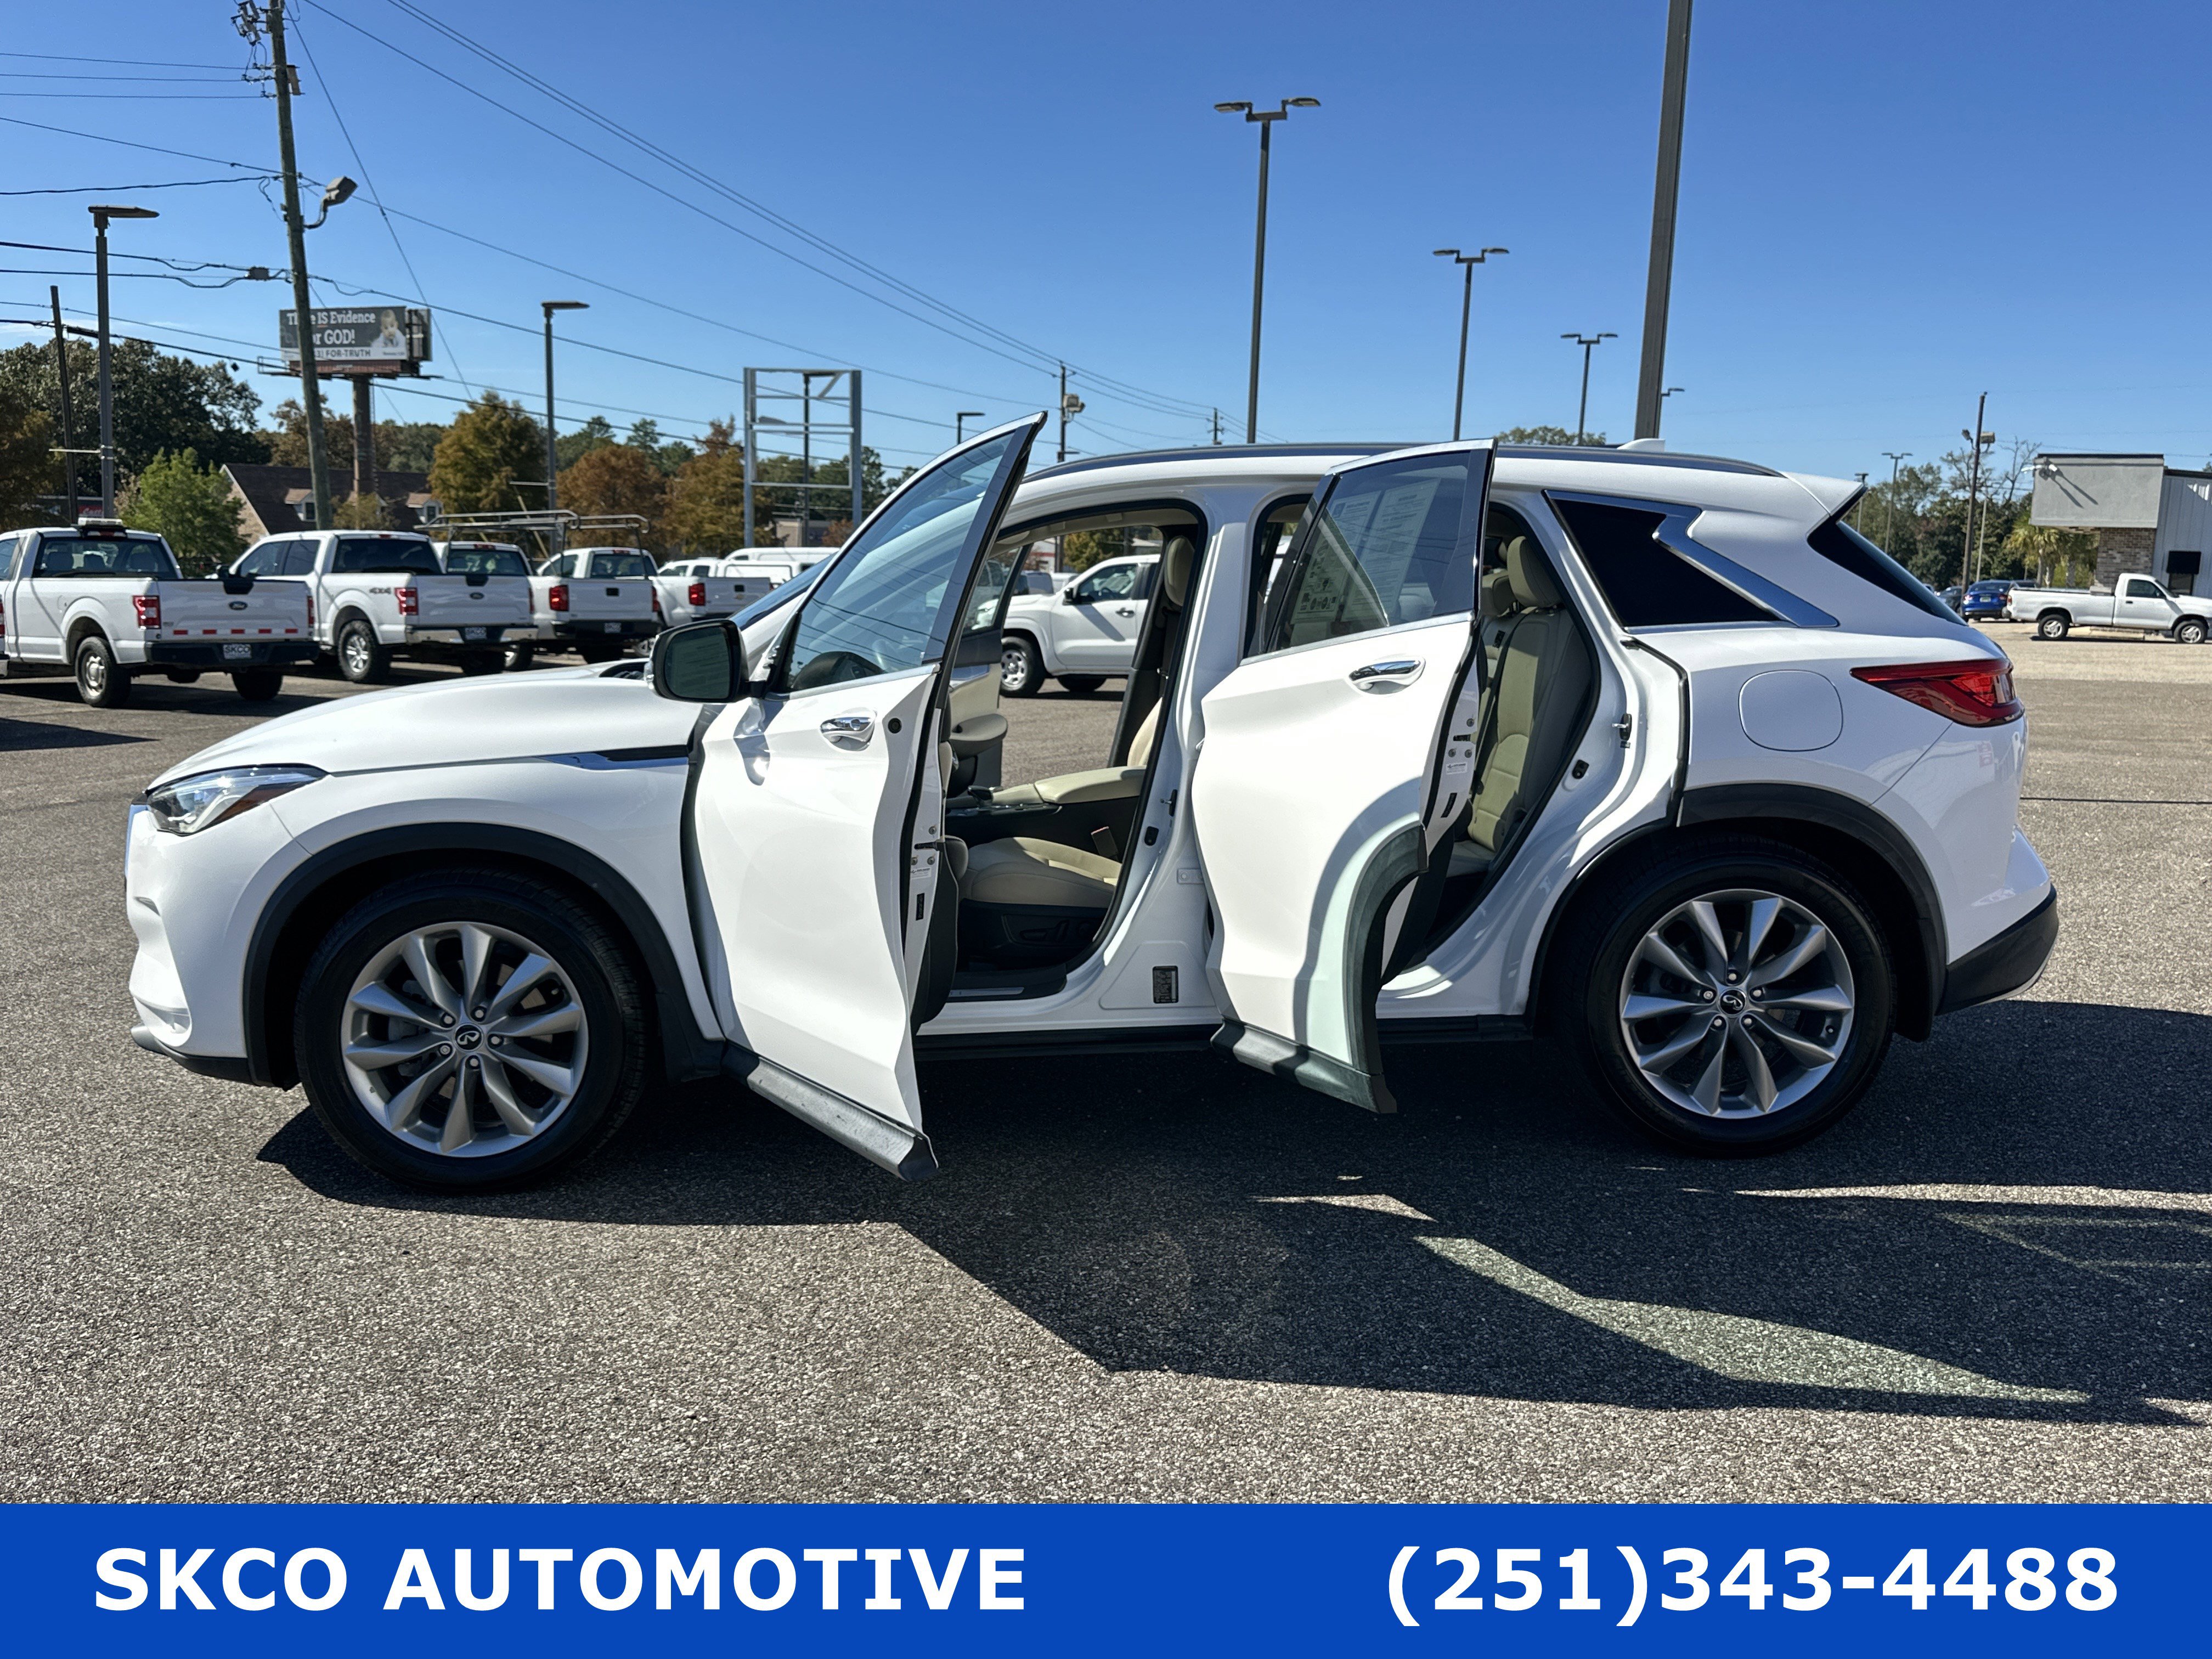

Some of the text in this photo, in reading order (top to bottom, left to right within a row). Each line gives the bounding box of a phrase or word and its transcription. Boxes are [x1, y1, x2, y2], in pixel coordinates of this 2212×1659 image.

[317, 311, 329, 324] IS
[330, 310, 376, 324] Evidence
[324, 329, 355, 345] GOD!
